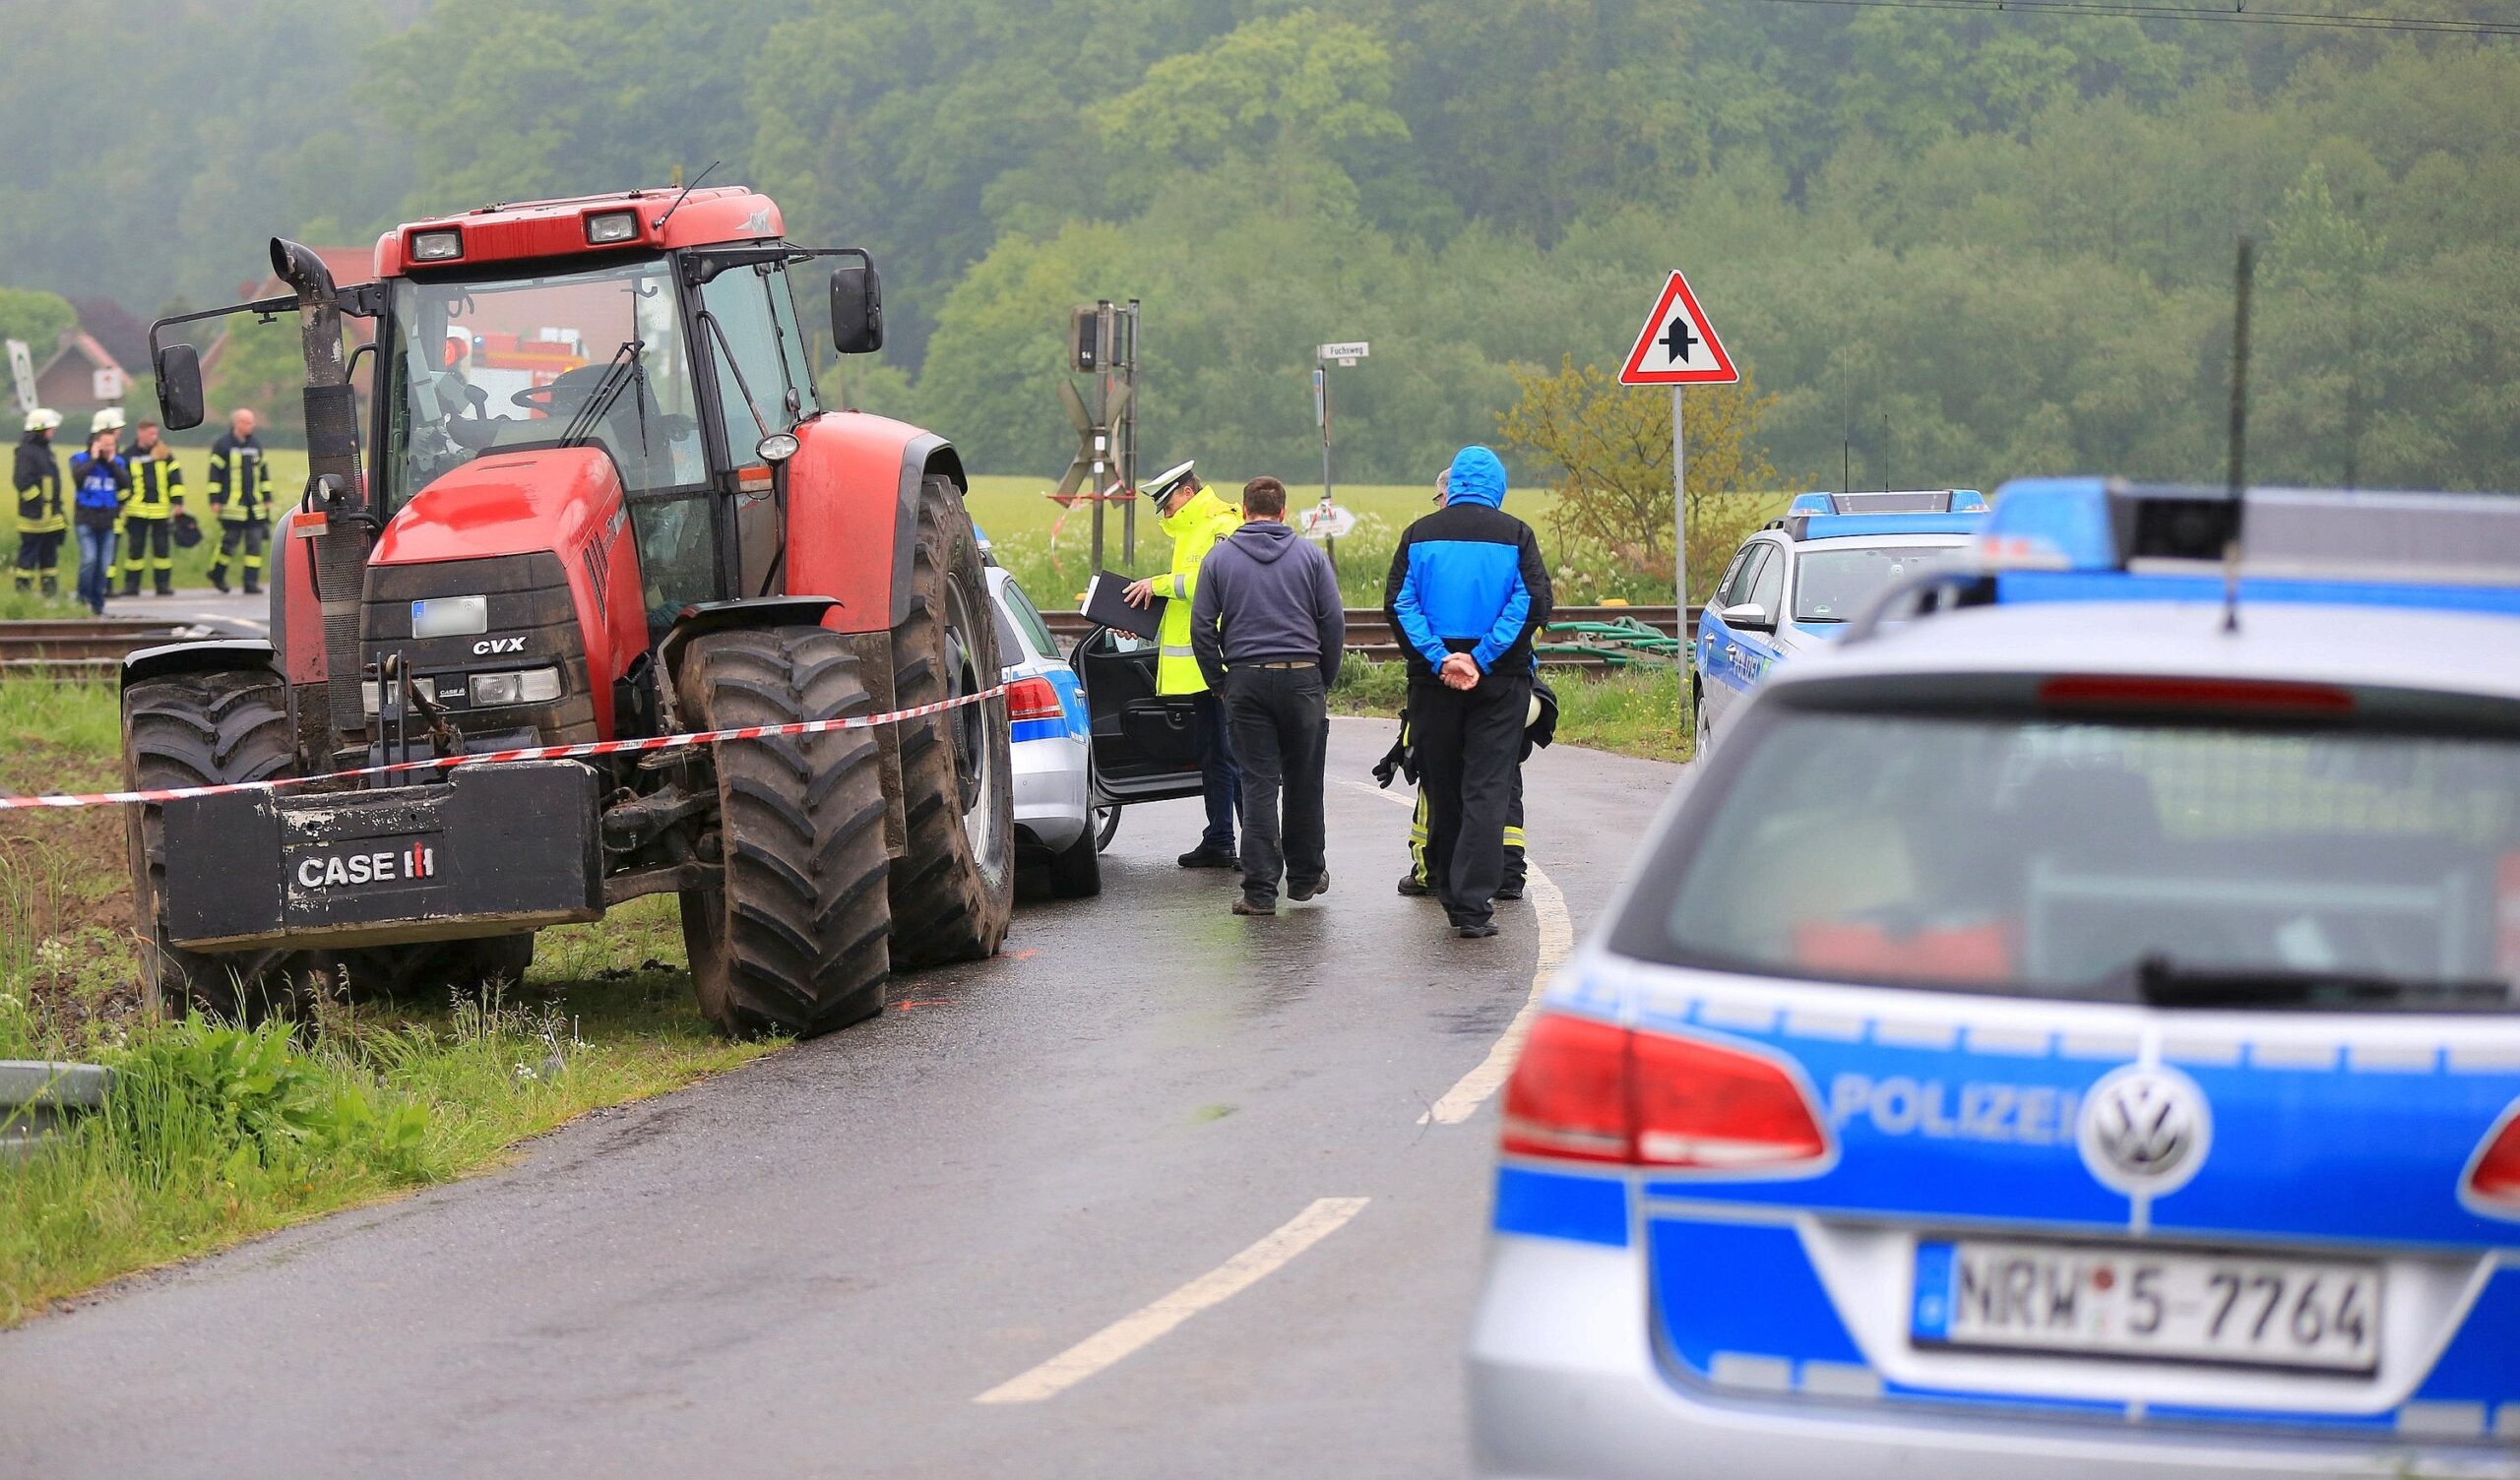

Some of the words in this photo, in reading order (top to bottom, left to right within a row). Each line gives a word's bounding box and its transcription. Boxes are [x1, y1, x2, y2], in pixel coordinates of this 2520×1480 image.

[1330, 346, 1363, 355] Fuchsweg
[472, 637, 527, 655] CVX
[297, 852, 396, 888] CASE
[1828, 1071, 2080, 1145] POLIZEI
[1959, 1260, 2079, 1330] NRW
